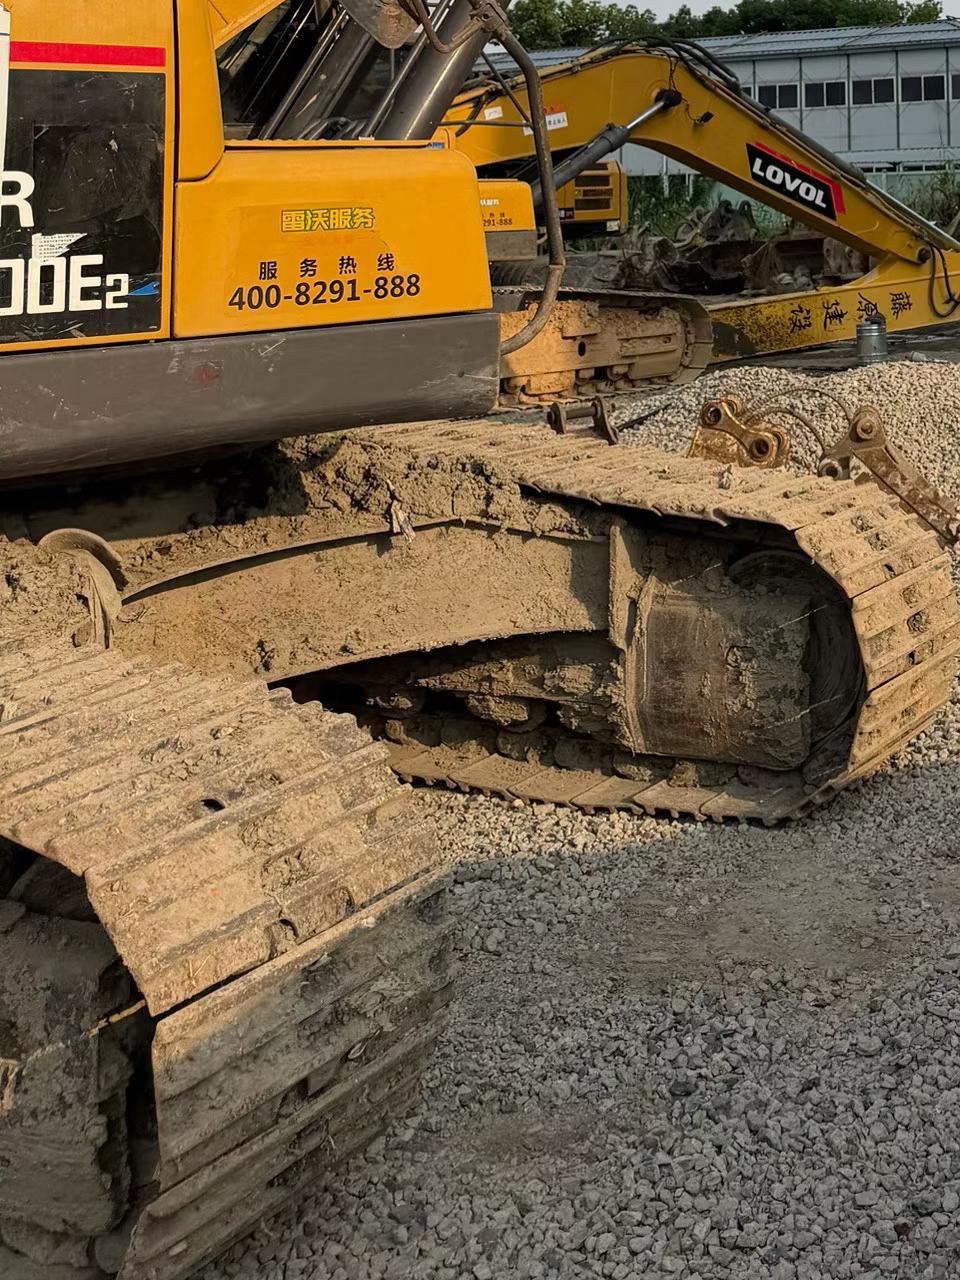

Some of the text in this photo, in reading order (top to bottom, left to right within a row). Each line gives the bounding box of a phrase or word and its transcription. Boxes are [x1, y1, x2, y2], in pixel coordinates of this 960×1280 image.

[752, 157, 827, 209] LOVOL
[281, 208, 375, 233] 雷沃服务
[259, 253, 395, 281] 服务热线
[228, 274, 421, 311] 400-8291-888
